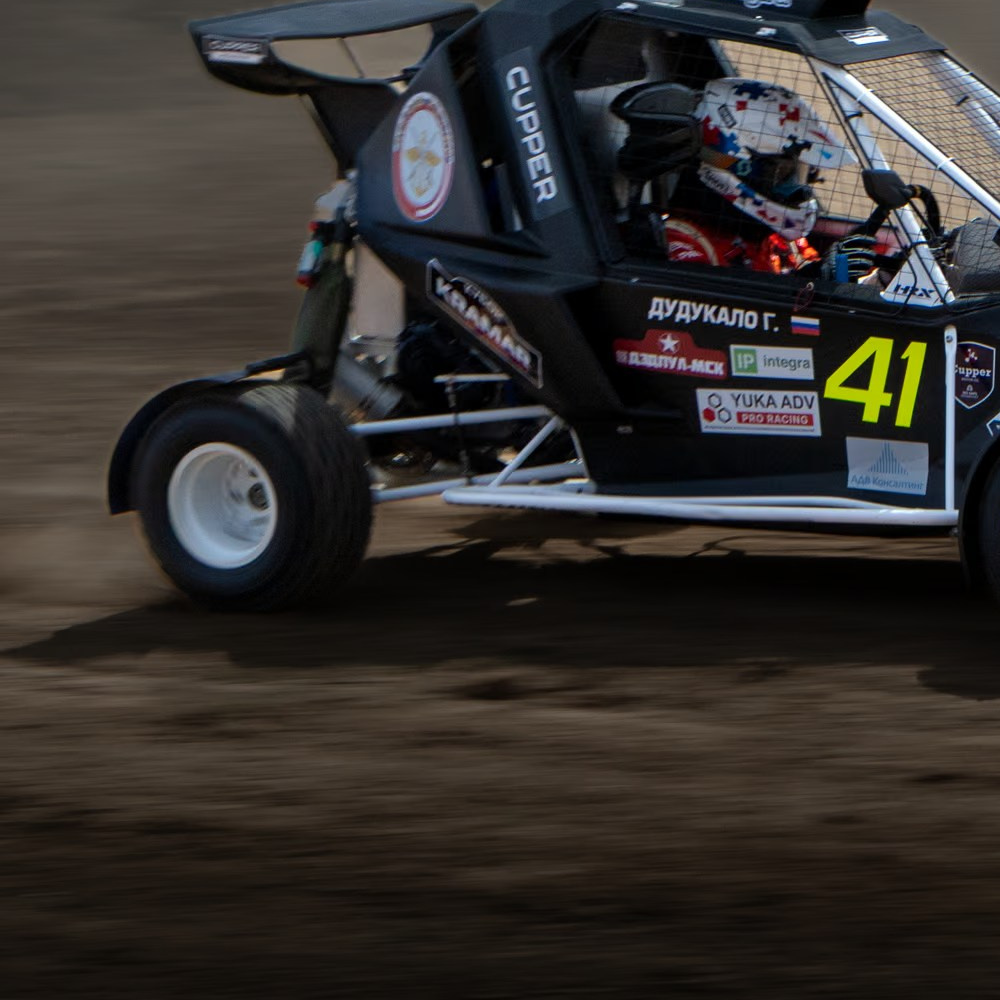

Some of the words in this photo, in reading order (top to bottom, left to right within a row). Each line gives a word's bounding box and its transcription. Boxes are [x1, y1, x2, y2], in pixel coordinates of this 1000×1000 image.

[506, 66, 557, 203] CUPPER
[648, 297, 758, 330] ДУДУКАЛО
[763, 312, 779, 332] Г.
[736, 353, 754, 370] IP
[763, 355, 811, 371] integra
[823, 336, 927, 428] 41
[731, 393, 777, 408] YUKA
[781, 394, 814, 409] ADV
[742, 413, 764, 424] PRO
[767, 414, 809, 425] RACING
